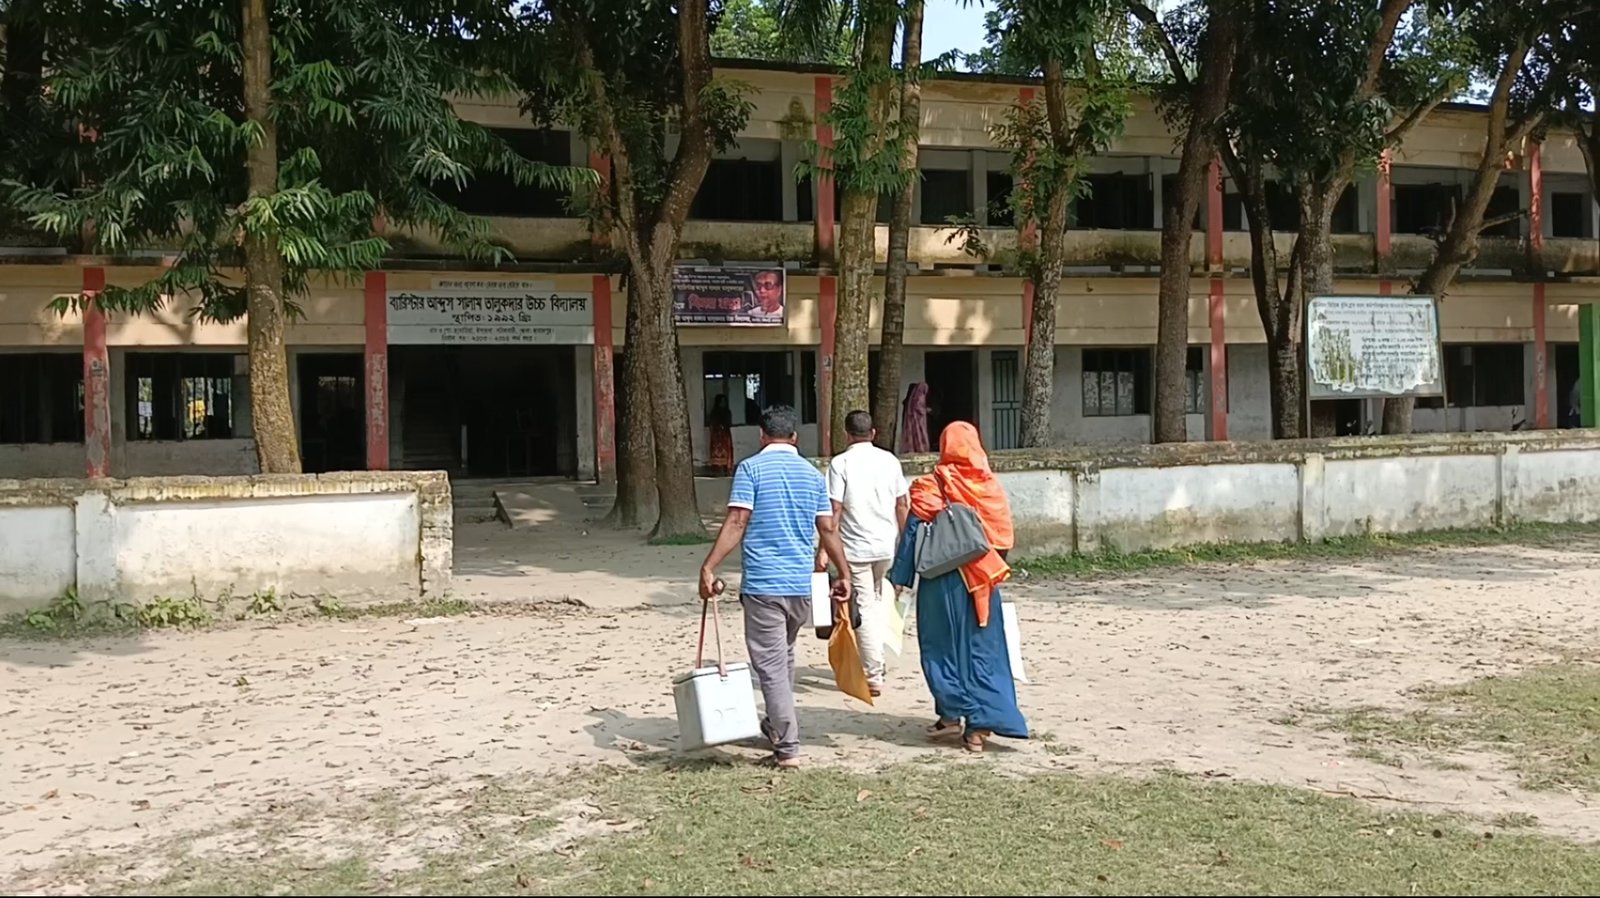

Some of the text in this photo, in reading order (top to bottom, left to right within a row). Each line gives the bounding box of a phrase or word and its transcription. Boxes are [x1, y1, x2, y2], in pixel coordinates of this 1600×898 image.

[456, 297, 482, 310] সালাম
[484, 297, 523, 313] তালুকদার
[525, 294, 546, 310] উচ্চ
[550, 294, 587, 312] বিদ্যালয়
[488, 314, 516, 323] ১৯৯২
